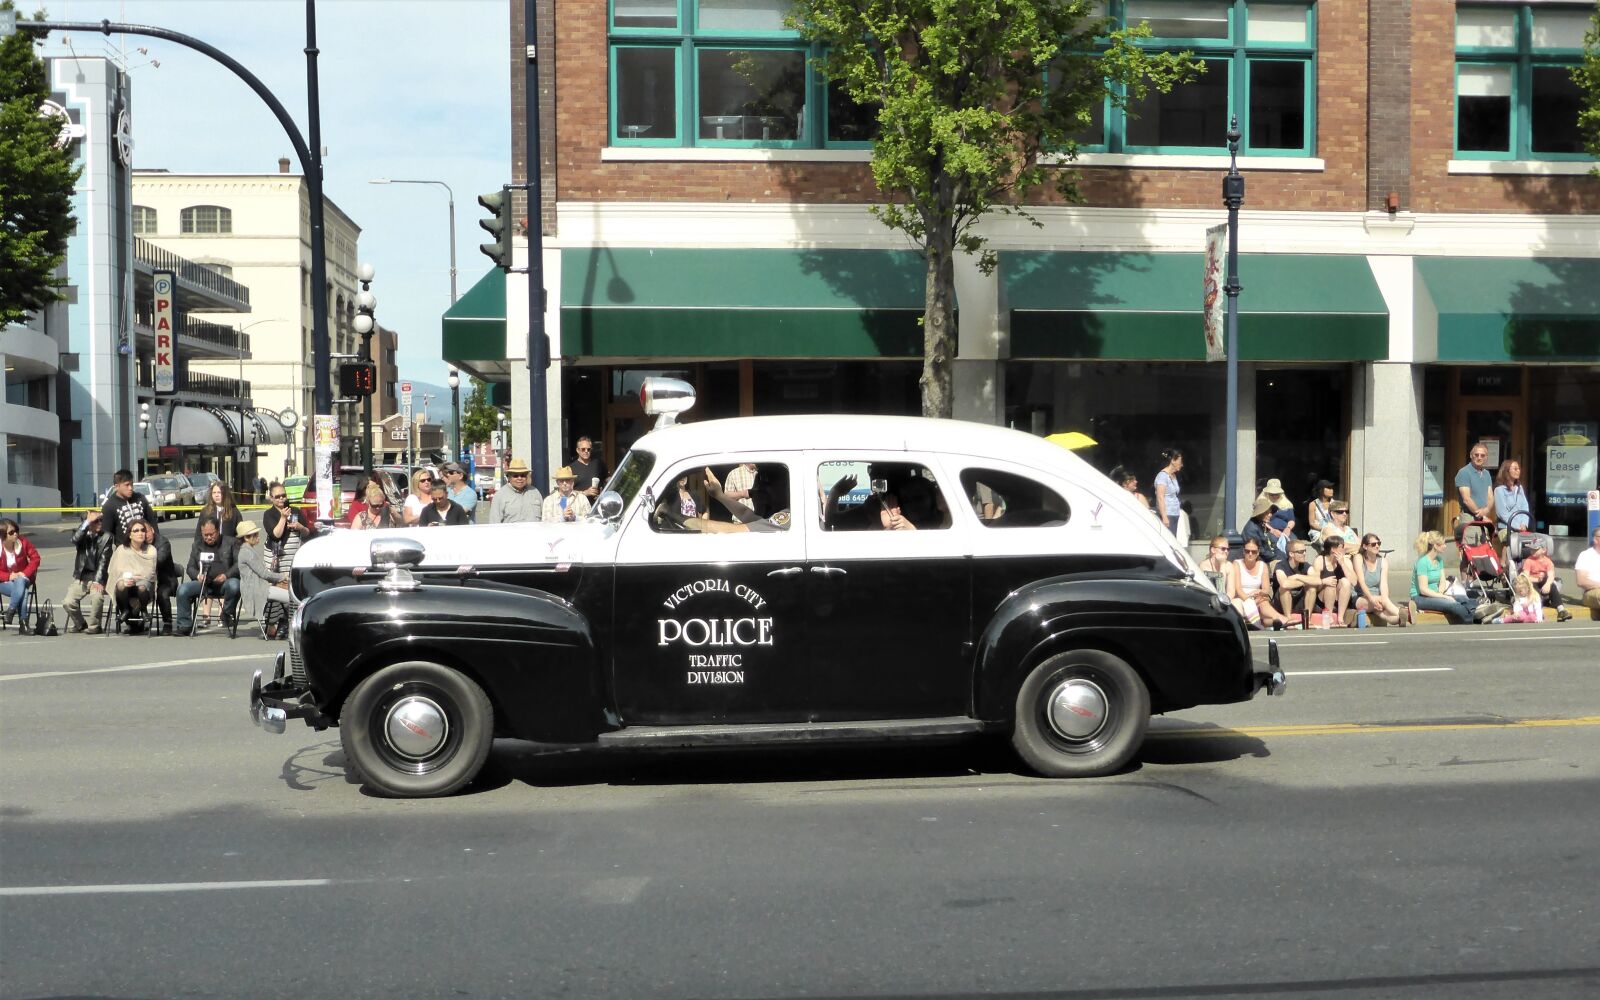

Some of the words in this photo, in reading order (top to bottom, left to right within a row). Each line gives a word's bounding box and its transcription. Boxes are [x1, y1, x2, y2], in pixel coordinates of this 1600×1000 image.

[157, 299, 170, 366] PARK
[1549, 450, 1566, 459] For
[1549, 461, 1580, 471] Lease
[663, 578, 730, 610] VICTORIA
[734, 584, 767, 610] CITY
[657, 616, 773, 647] POLICE
[688, 654, 742, 667] TRAFFIC
[687, 671, 745, 684] DIVISION
